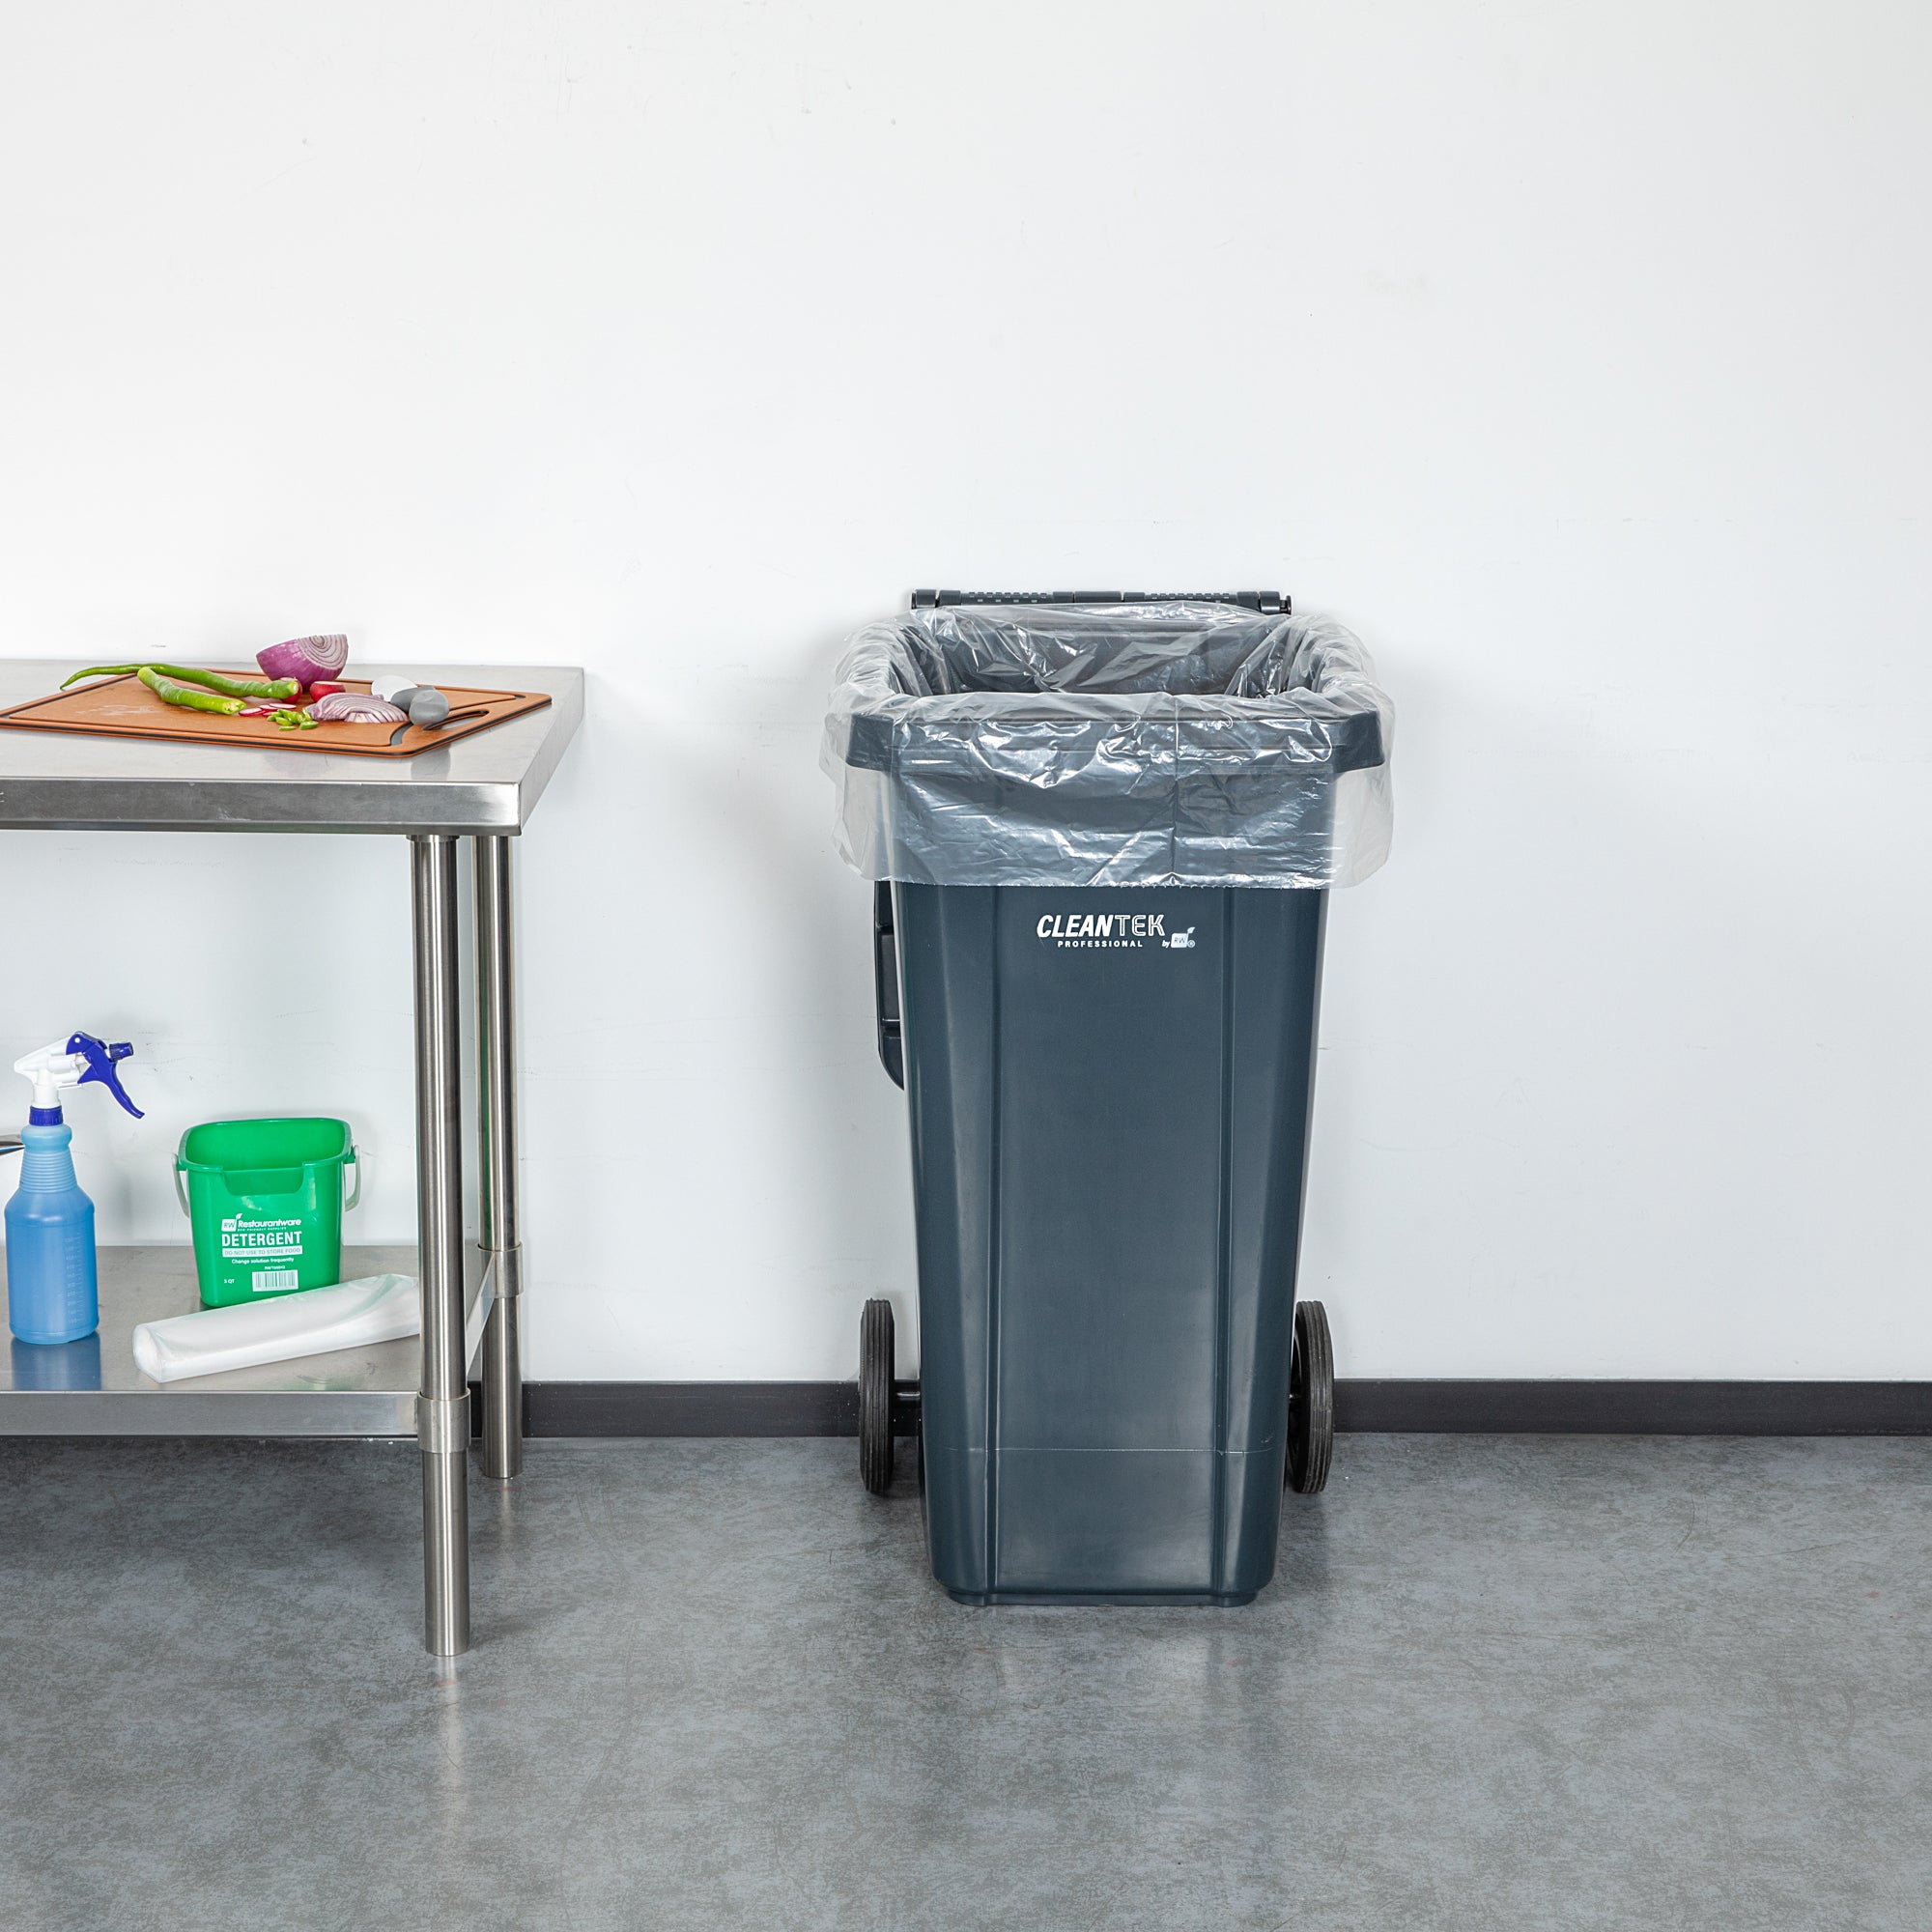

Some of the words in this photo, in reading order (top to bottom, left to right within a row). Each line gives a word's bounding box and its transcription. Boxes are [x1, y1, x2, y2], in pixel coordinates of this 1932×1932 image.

[1037, 914, 1165, 938] CLEANTEK
[1161, 939, 1170, 949] by
[238, 1218, 301, 1228] Restaurantware
[221, 1231, 302, 1247] DETERGENT
